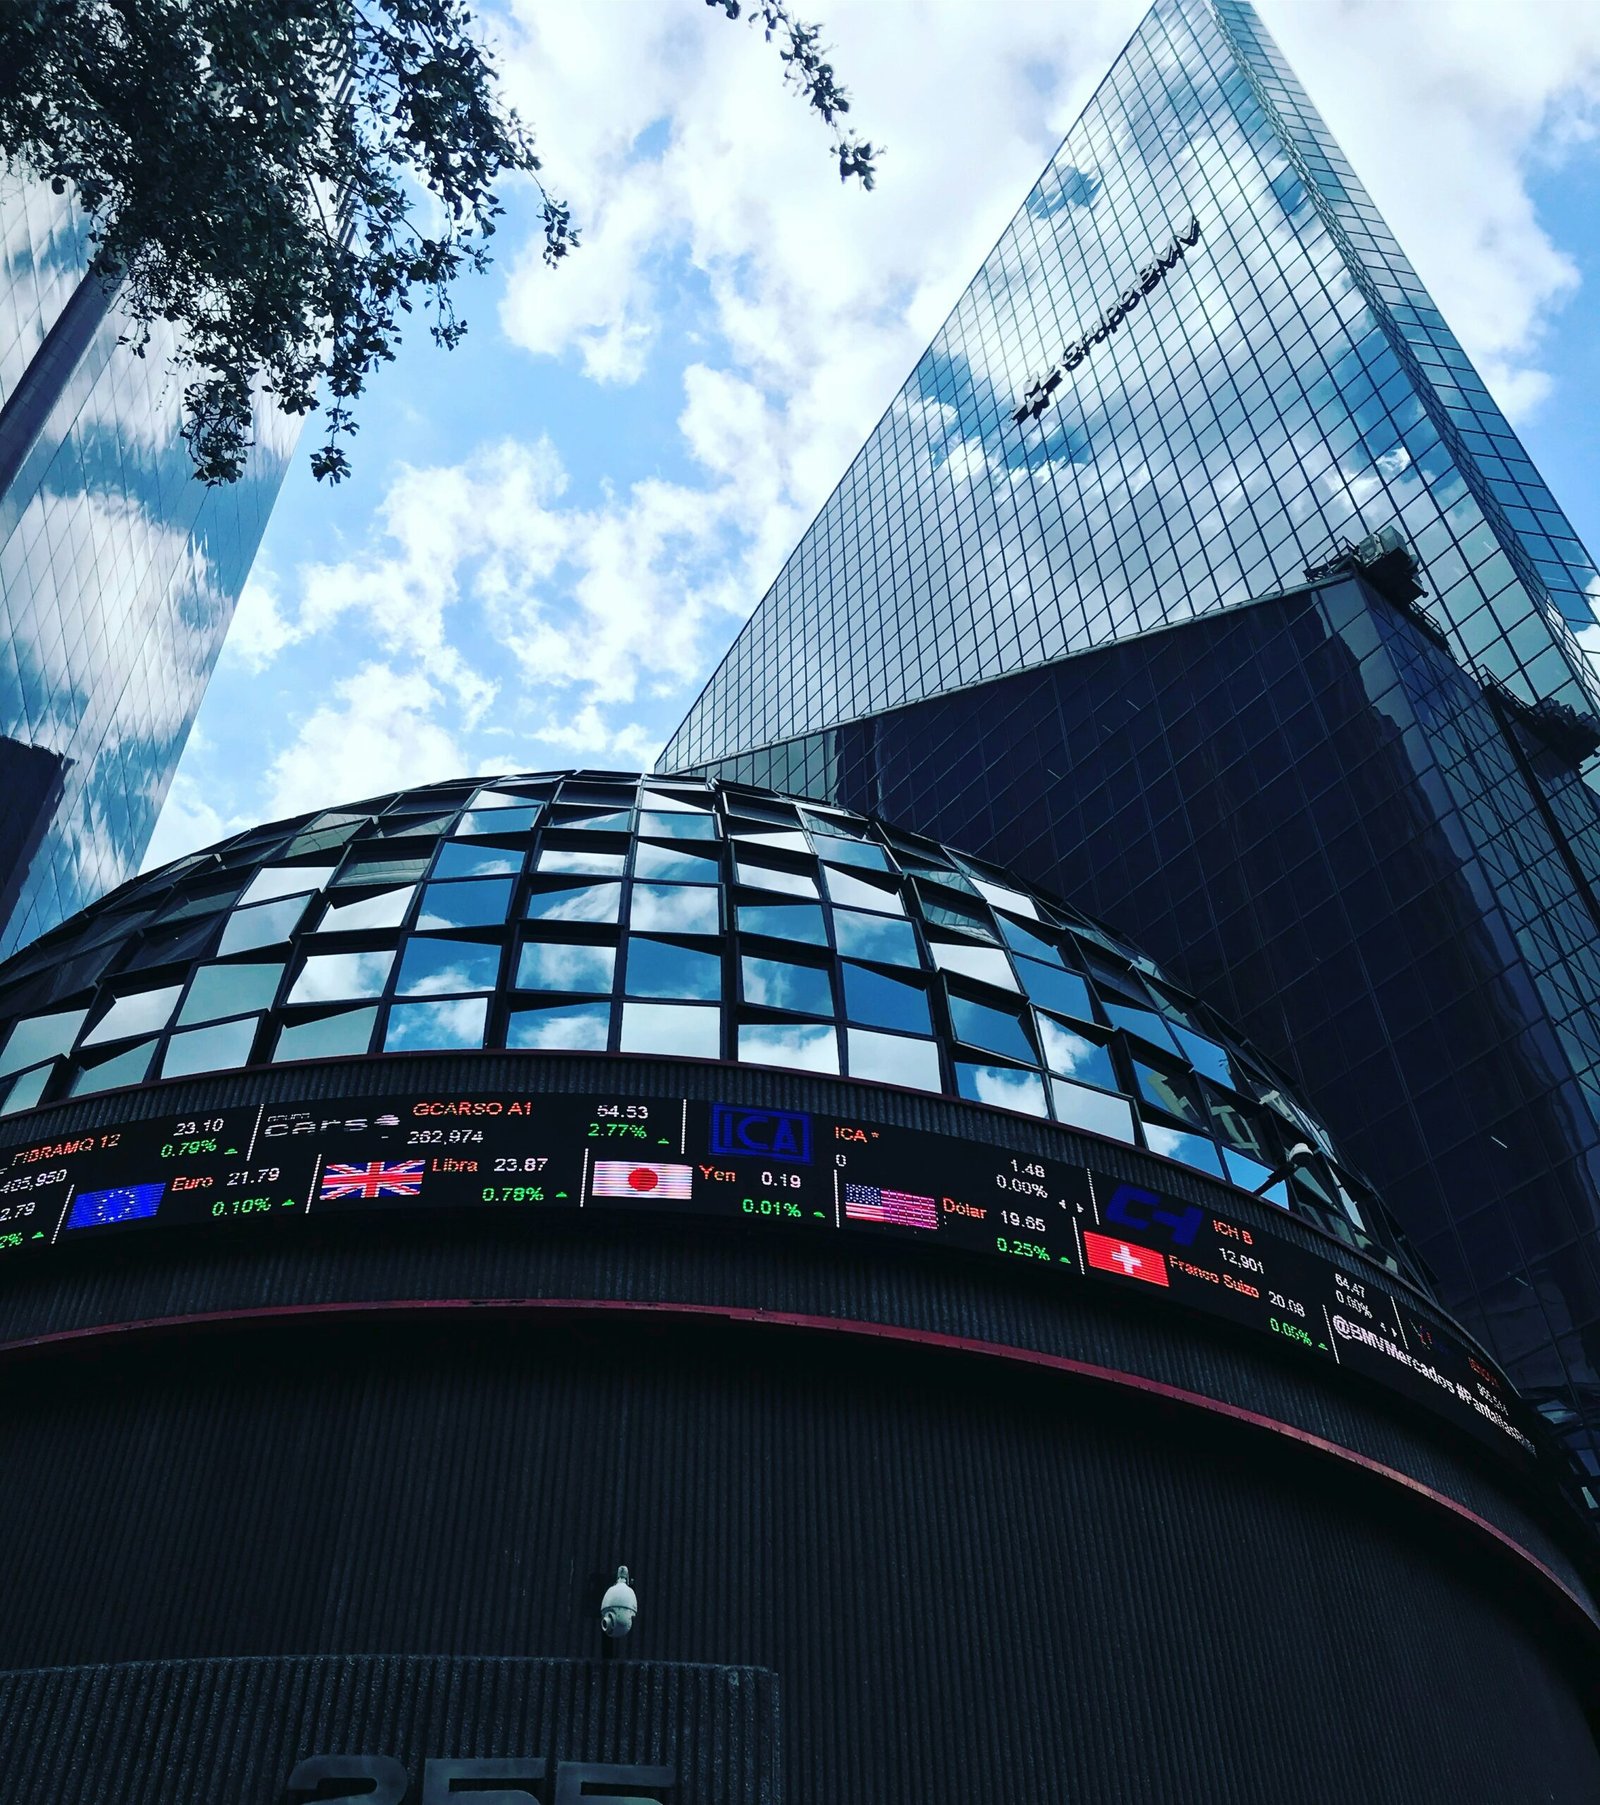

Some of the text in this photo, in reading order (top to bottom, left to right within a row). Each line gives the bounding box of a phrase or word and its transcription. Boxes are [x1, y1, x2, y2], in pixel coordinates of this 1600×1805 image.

[412, 1101, 532, 1116] GCARSO A1
[173, 1118, 225, 1137] 23.10
[406, 1129, 484, 1145] 262,974
[587, 1123, 648, 1139] 2.77%
[722, 1112, 798, 1153] ICA
[835, 1126, 868, 1143] ICA
[101, 1133, 121, 1148] 12
[432, 1157, 549, 1172] Libra 23.87
[835, 1153, 847, 1167] 0
[1010, 1159, 1046, 1180] 1.48
[171, 1167, 280, 1192] Euro 21.79
[698, 1164, 802, 1189] Yen 0.19
[996, 1172, 1049, 1199] 0.00%
[482, 1186, 544, 1202] 0.78%
[211, 1197, 272, 1217] 0.10%
[742, 1198, 802, 1218] 0.01%
[1212, 1219, 1253, 1245] ICH B
[996, 1237, 1051, 1261] 0.25%
[1218, 1247, 1265, 1275] 12,901
[1166, 1254, 1260, 1299] Franco Suizo
[1269, 1315, 1313, 1347] 0.05%
